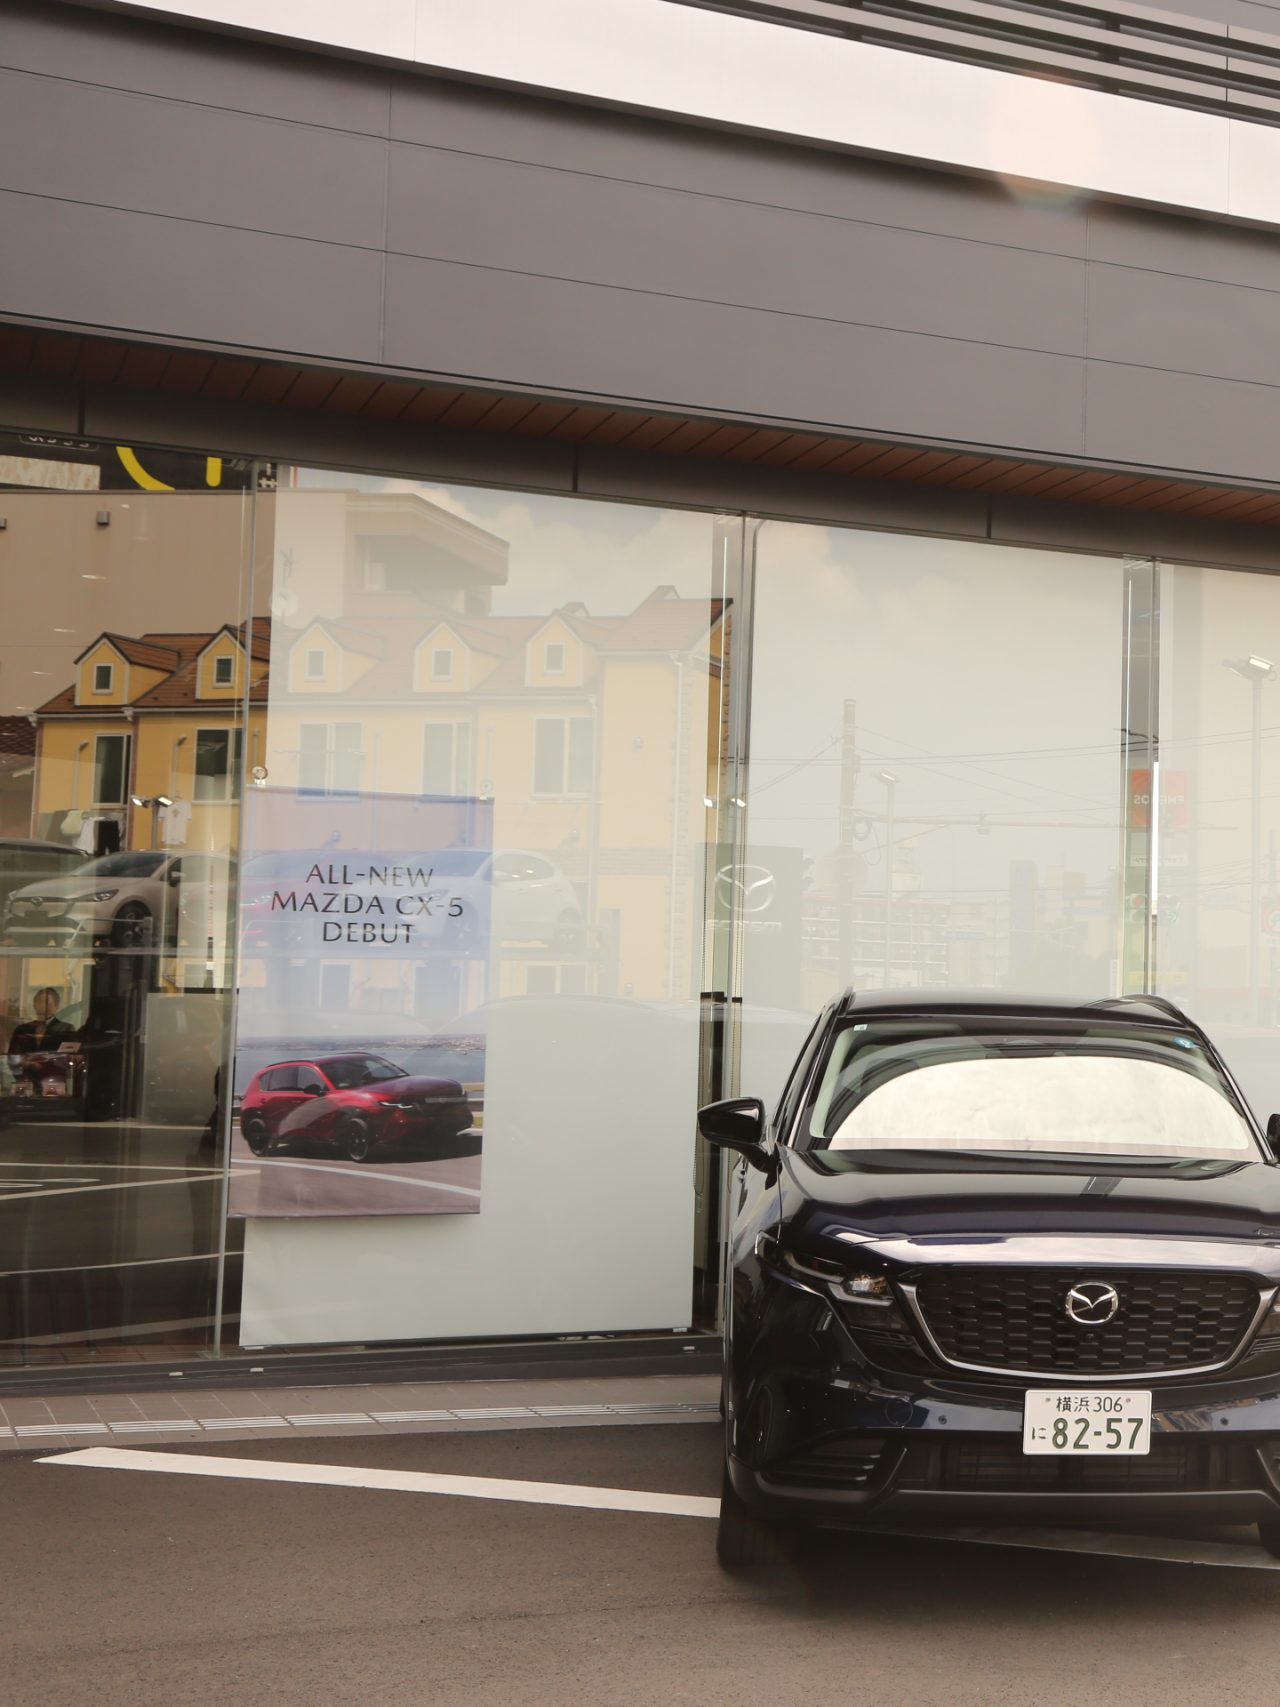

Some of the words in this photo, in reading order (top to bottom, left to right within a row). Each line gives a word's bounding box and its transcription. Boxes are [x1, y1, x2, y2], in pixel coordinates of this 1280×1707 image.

[306, 863, 434, 887] ALL-NEW
[271, 890, 385, 915] MAZDA
[396, 895, 464, 918] CX-5
[323, 921, 415, 944] DEBUT
[1031, 1426, 1047, 1440] に
[1052, 1417, 1144, 1449] 82-57
